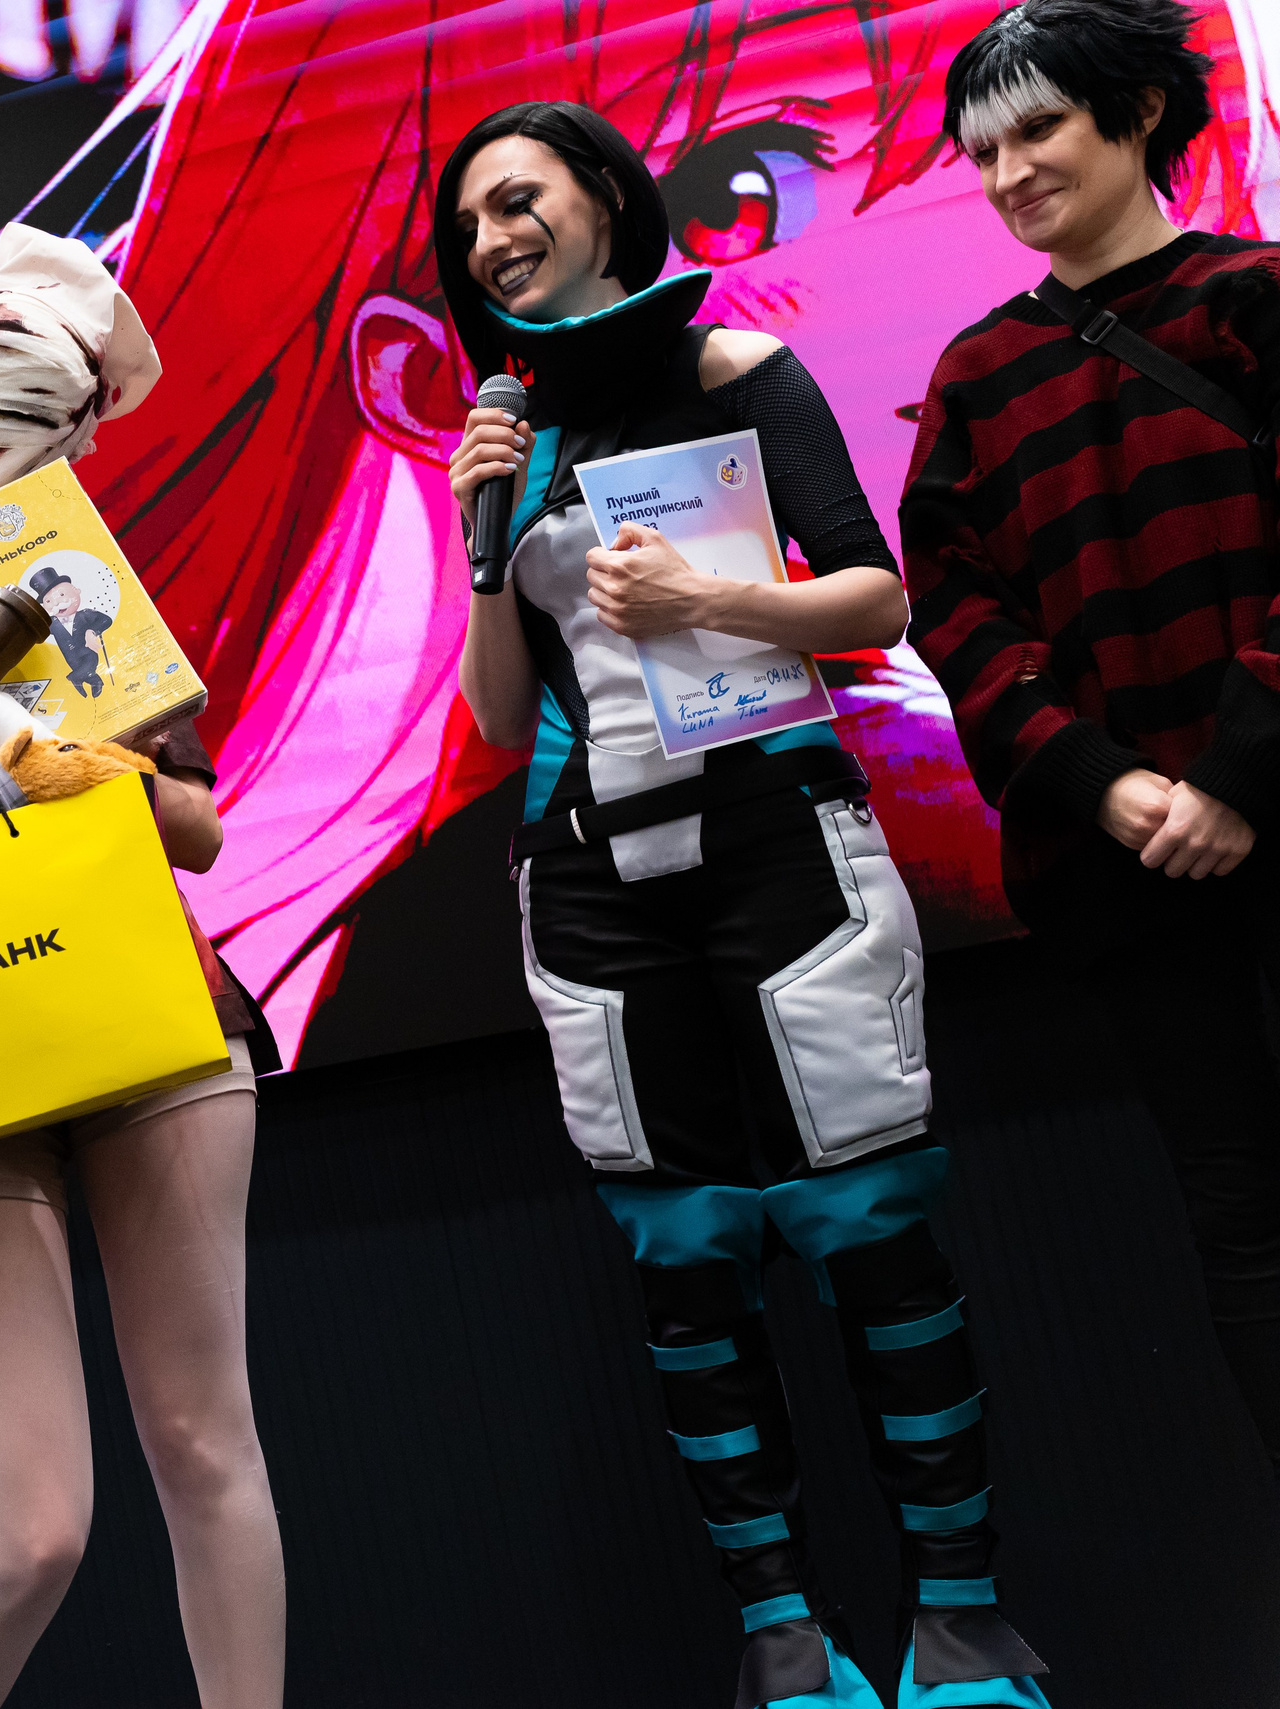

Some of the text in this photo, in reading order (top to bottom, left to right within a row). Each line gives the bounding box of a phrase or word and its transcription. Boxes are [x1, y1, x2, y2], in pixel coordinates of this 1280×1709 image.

[606, 487, 661, 509] Лучший
[611, 496, 703, 524] хеллоуинский
[753, 675, 767, 684] Дата
[676, 690, 705, 702] Подпись
